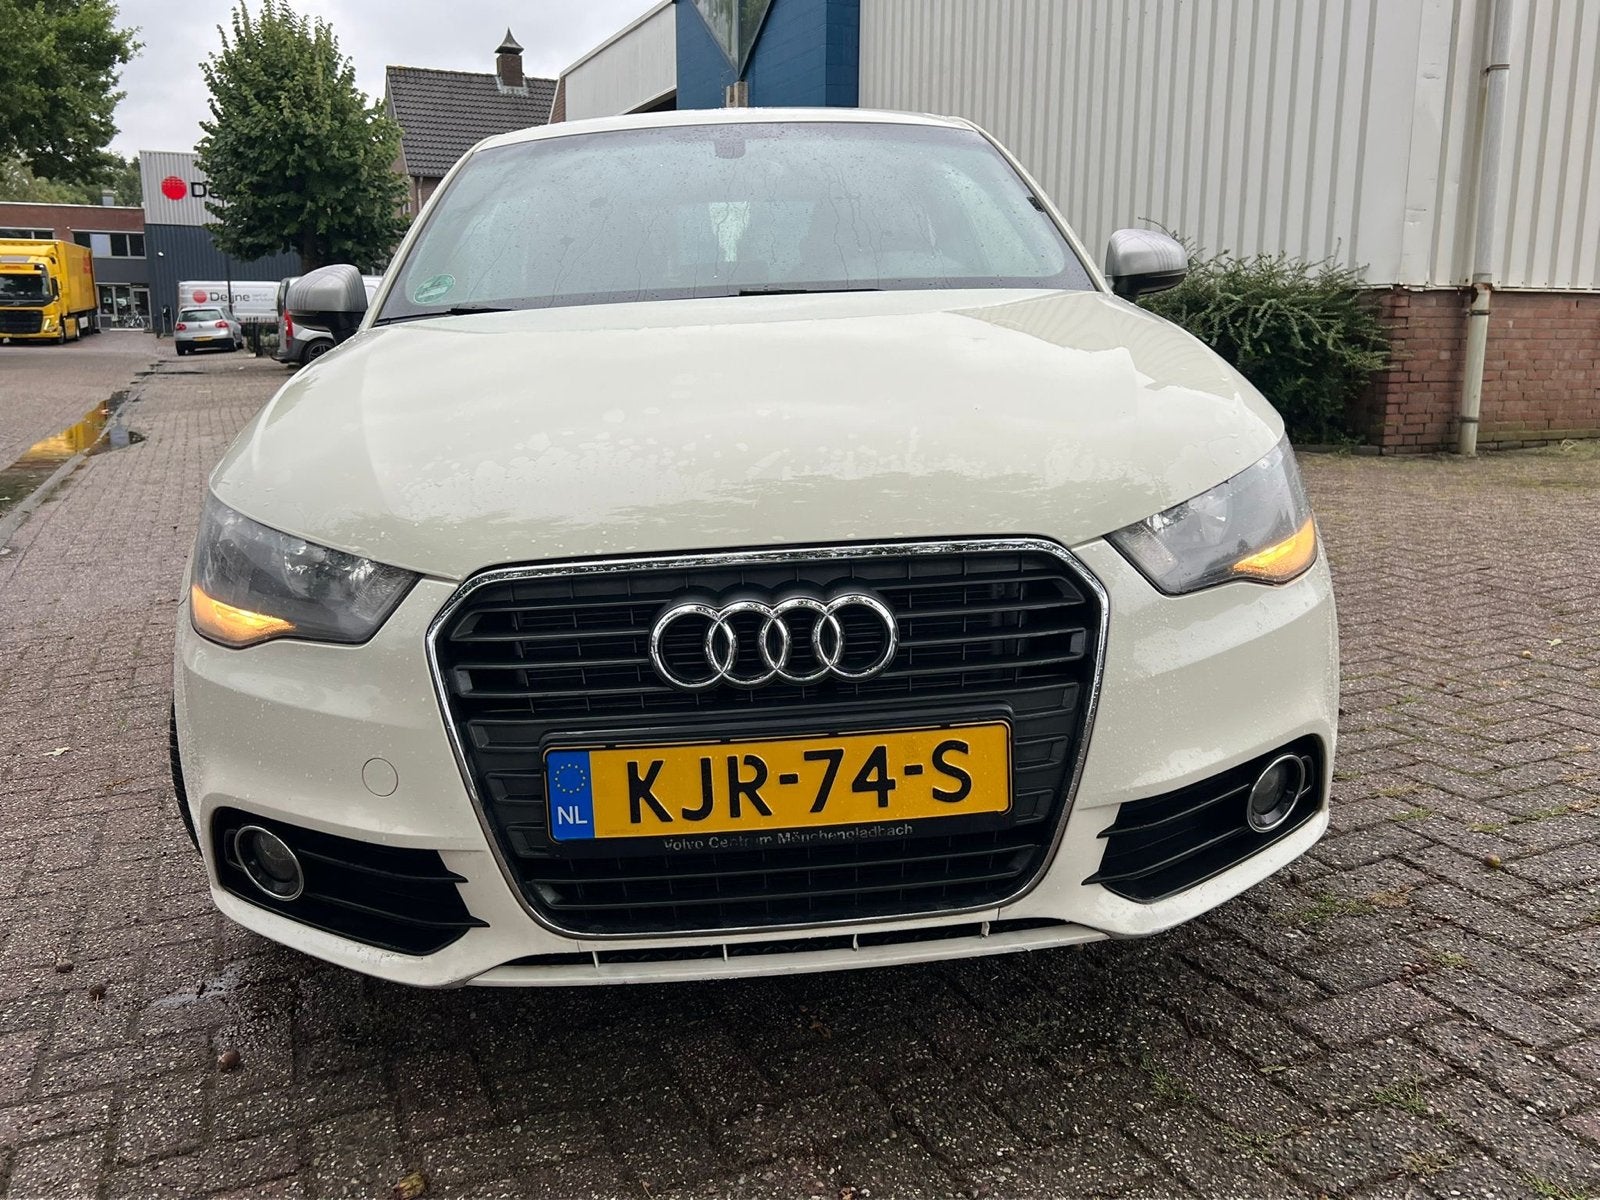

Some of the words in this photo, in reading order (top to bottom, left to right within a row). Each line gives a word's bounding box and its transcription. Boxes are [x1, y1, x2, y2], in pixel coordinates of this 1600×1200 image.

[627, 739, 972, 823] KJR-74-S
[557, 806, 588, 825] NL
[664, 839, 704, 850] Volvo
